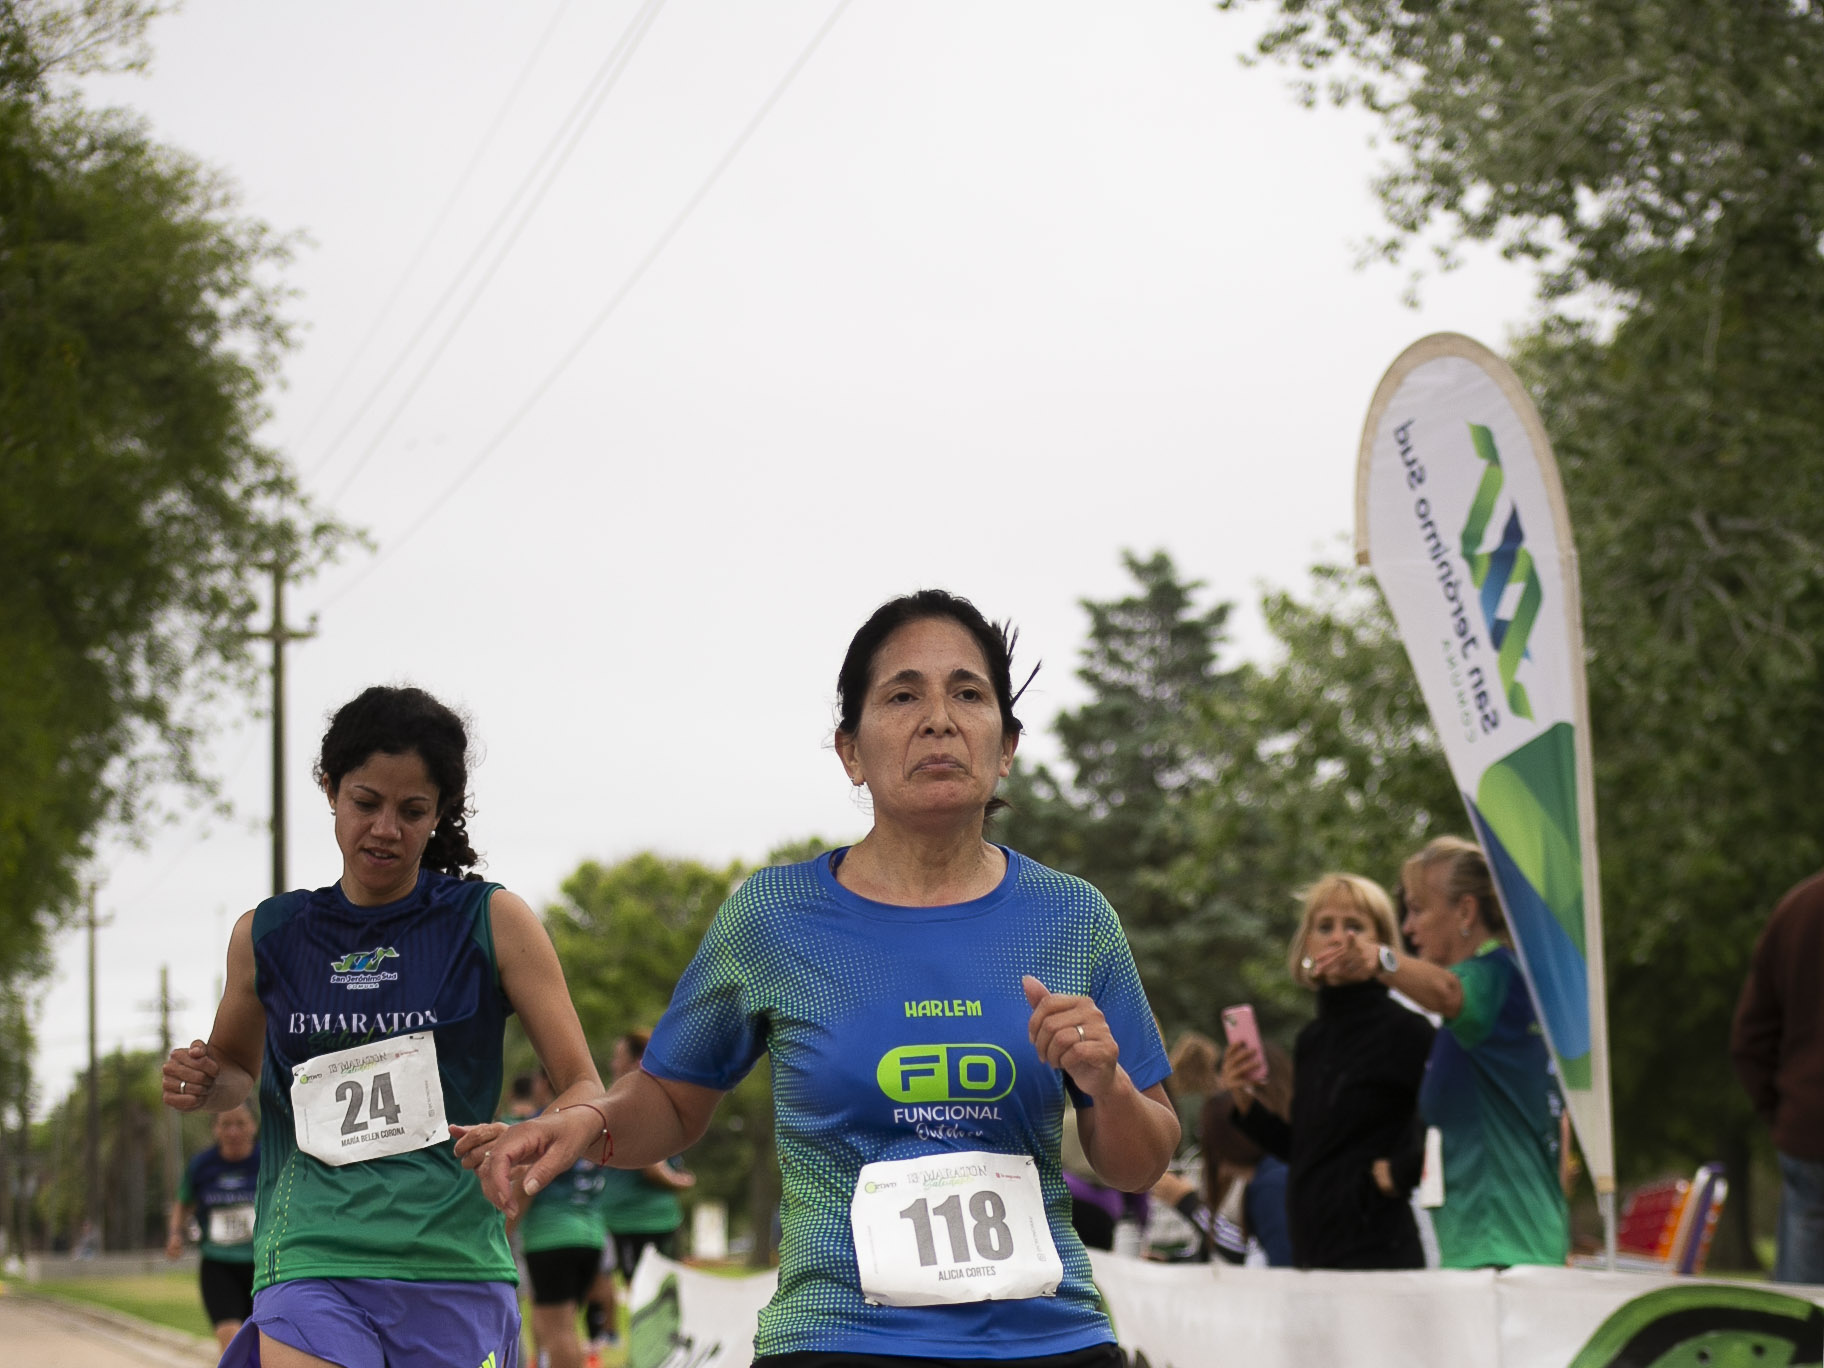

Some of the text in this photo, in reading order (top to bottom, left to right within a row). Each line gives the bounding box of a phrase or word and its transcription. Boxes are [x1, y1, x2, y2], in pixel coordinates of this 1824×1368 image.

[904, 1000, 982, 1017] HARLEM
[335, 1072, 401, 1136] 24
[893, 1105, 1002, 1124] FUNCIONAL
[381, 1127, 405, 1139] CORONA
[899, 1190, 1014, 1267] 118
[938, 1265, 996, 1281] ALICIA CORTES
